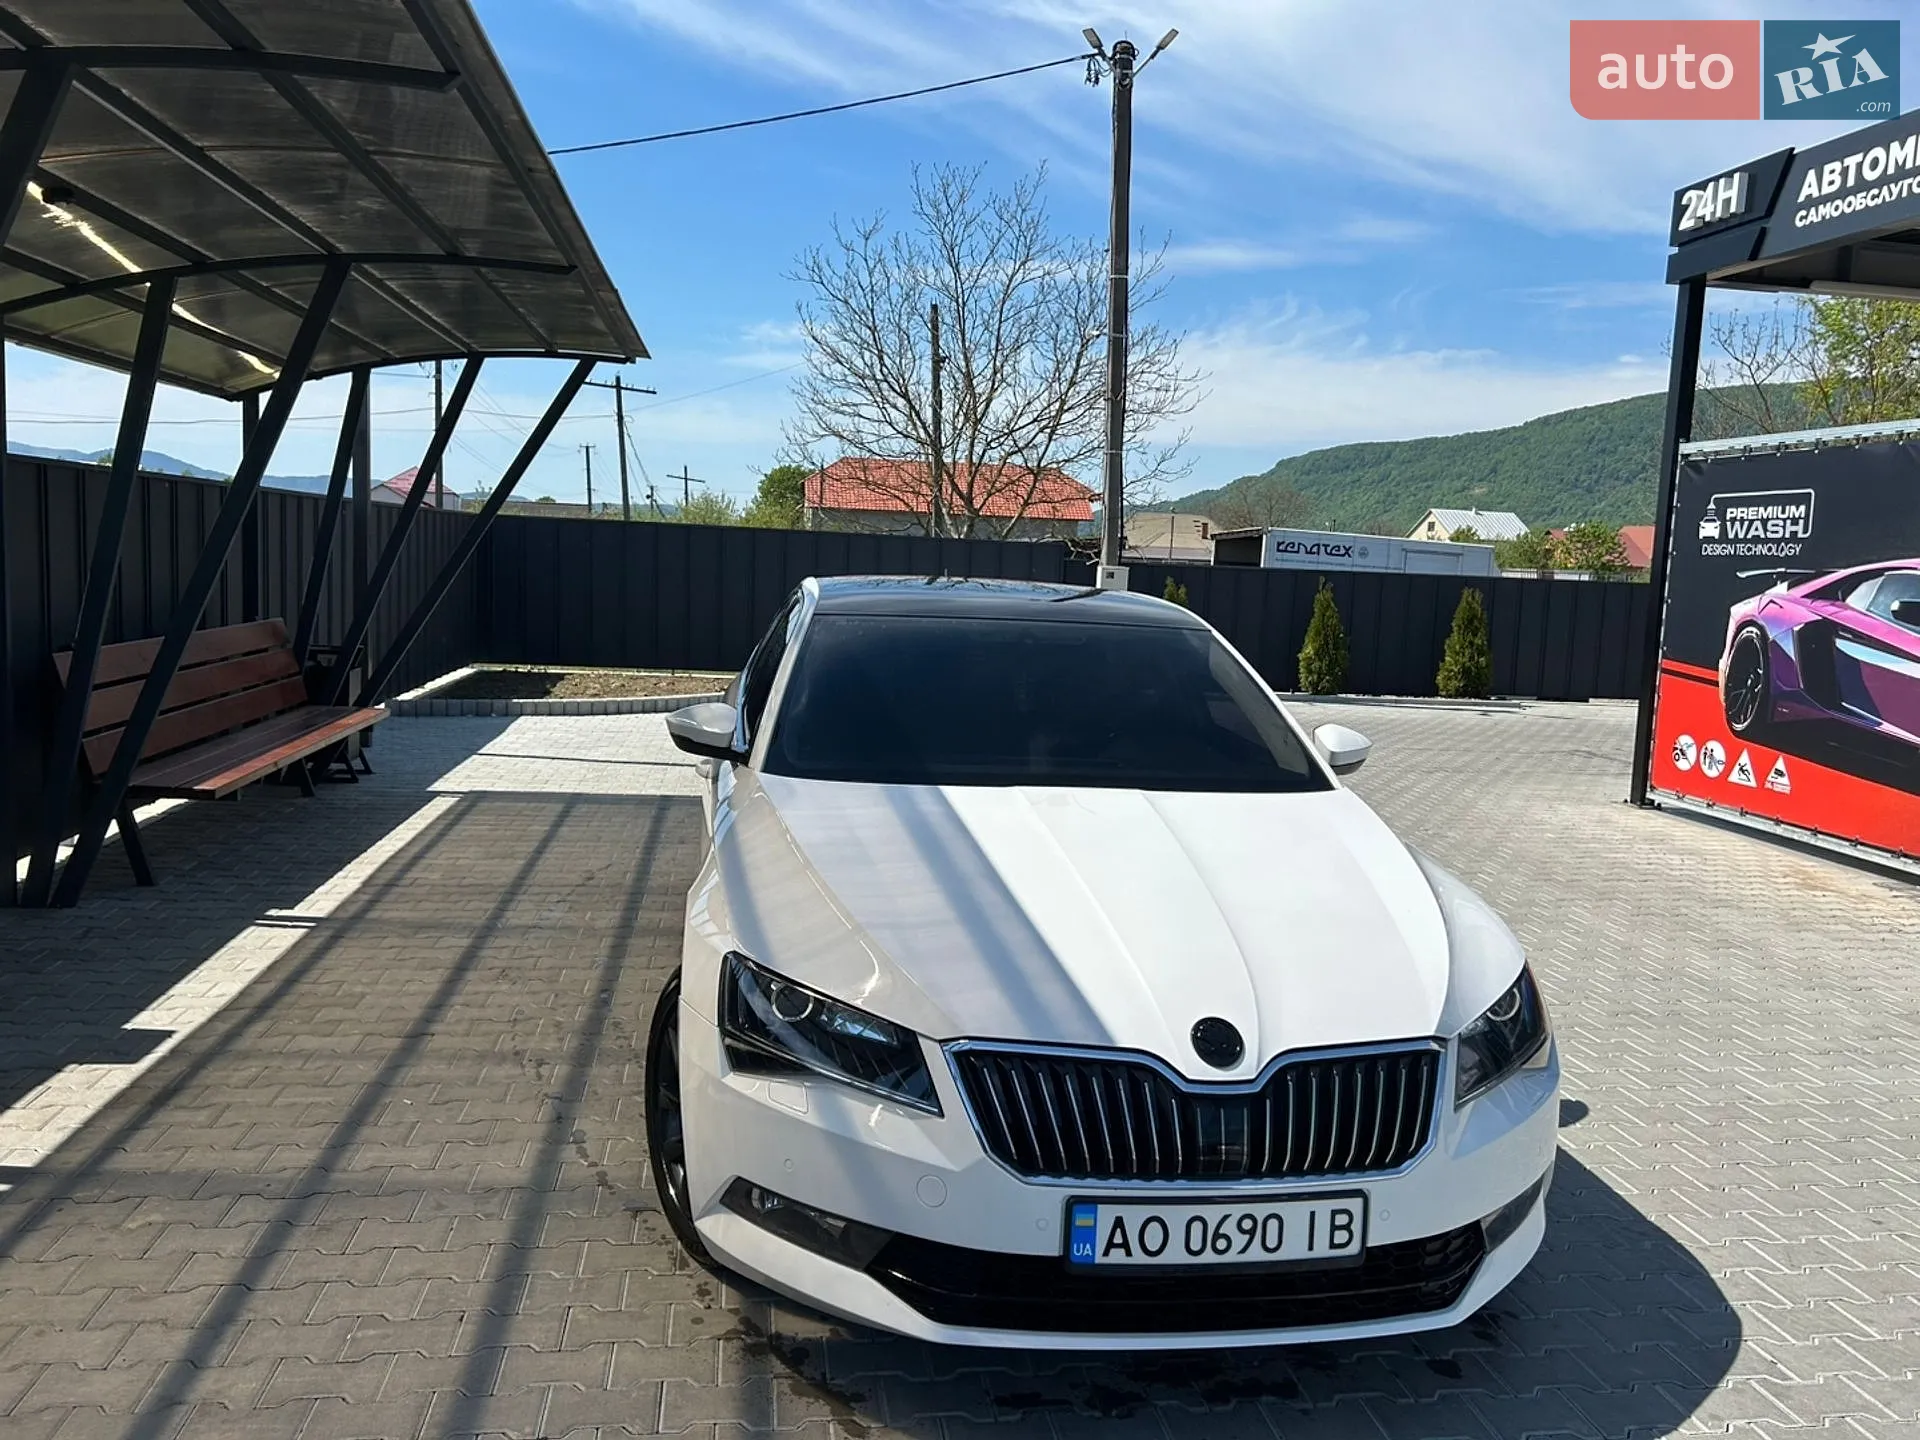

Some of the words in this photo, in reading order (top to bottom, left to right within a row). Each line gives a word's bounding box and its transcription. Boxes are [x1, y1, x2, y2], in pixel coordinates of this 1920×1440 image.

[1797, 134, 1920, 203] АВТОМ
[1678, 172, 1748, 231] 24H
[1726, 505, 1805, 520] PREMIUM
[1726, 519, 1804, 539] WASH
[1701, 543, 1734, 556] DESIGN
[1736, 543, 1802, 557] TECHNOLOGY
[1102, 1215, 1170, 1258] AO
[1184, 1213, 1284, 1257] 0690
[1307, 1208, 1354, 1251] IB
[1073, 1243, 1093, 1256] UA
